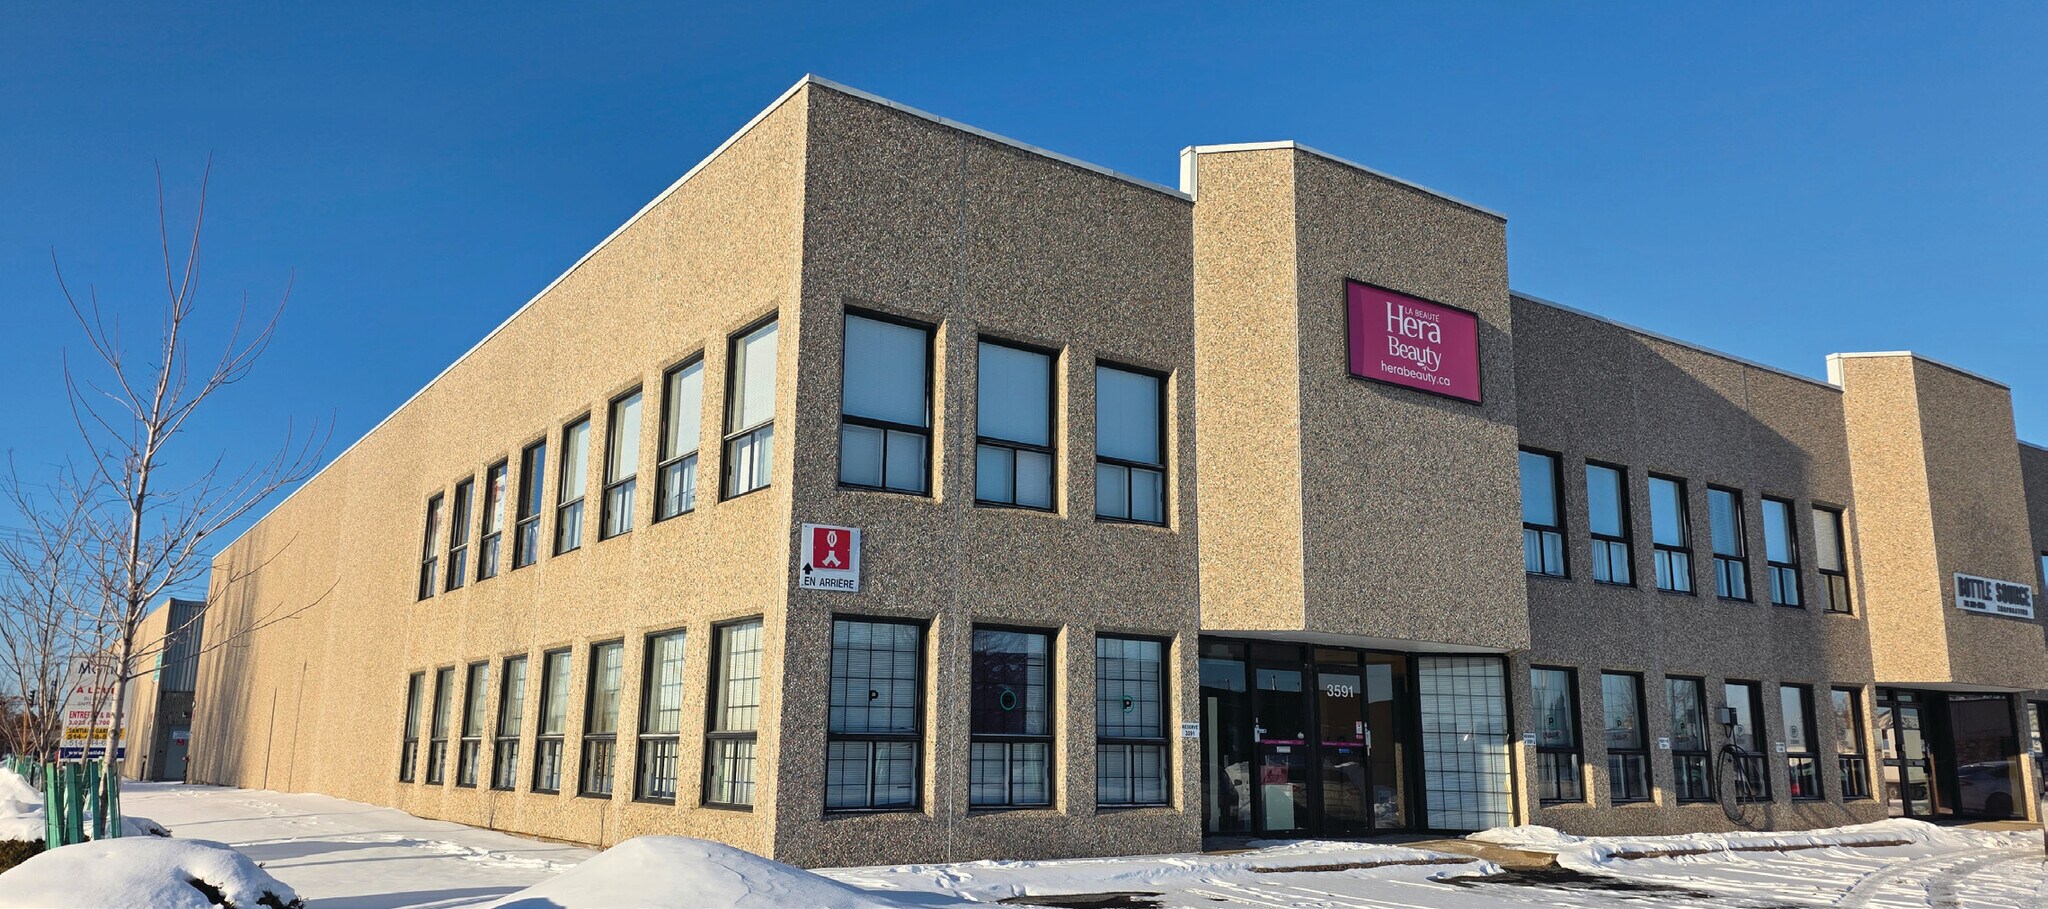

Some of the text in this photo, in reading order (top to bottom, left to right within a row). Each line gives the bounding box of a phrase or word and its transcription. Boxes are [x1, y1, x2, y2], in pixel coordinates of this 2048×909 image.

[1386, 301, 1441, 345] Hera
[1387, 335, 1442, 372] Beauty
[1381, 360, 1451, 386] herabeauty.ca
[804, 576, 816, 586] EN
[1957, 576, 1993, 601] BOTTLE
[869, 689, 879, 702] P
[1326, 684, 1354, 698] 3591
